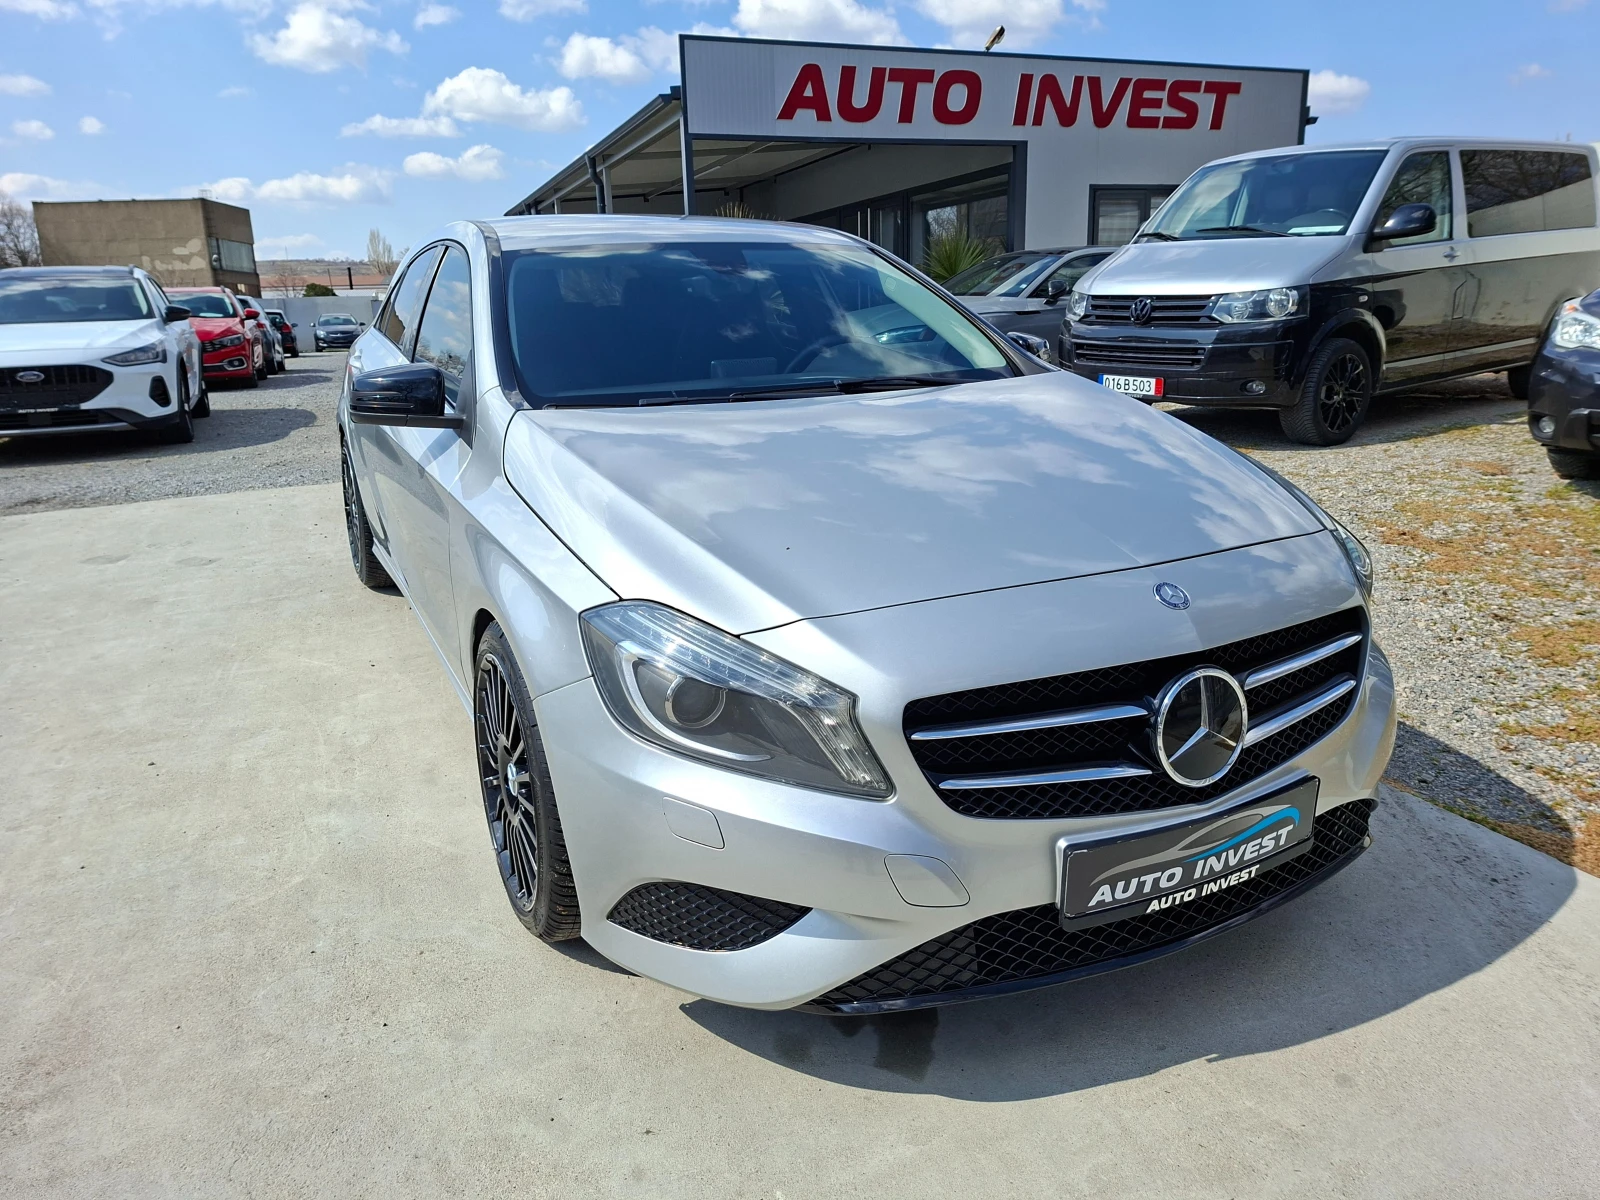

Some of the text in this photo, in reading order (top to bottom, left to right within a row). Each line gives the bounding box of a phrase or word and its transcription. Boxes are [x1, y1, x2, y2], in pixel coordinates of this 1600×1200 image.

[776, 63, 1242, 131] AUTO INVEST
[1087, 824, 1294, 907] AUTO INVEST
[1146, 864, 1260, 913] AUTO INVEST
